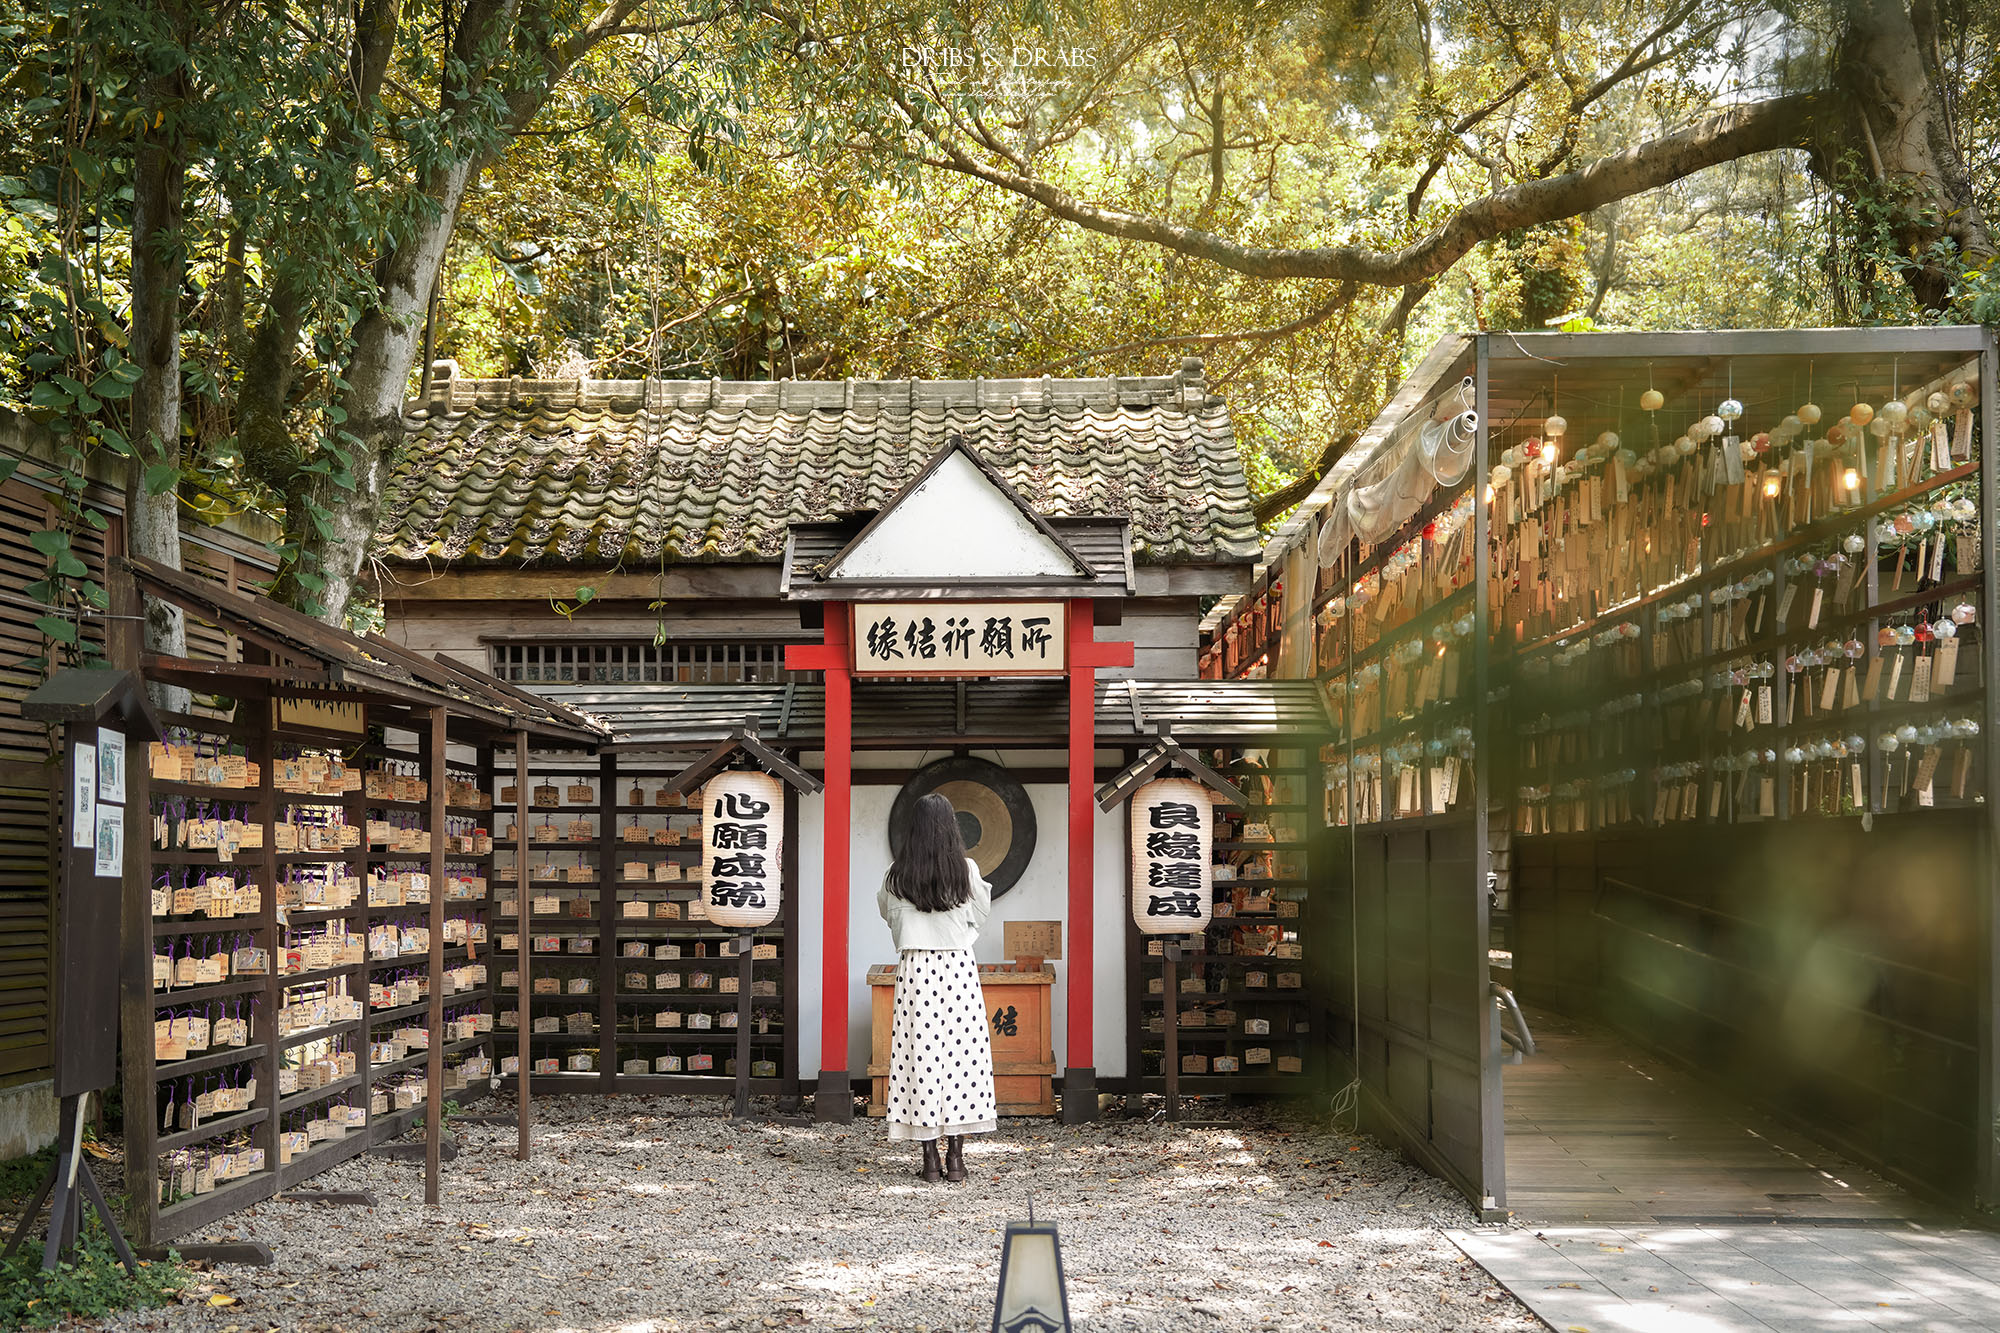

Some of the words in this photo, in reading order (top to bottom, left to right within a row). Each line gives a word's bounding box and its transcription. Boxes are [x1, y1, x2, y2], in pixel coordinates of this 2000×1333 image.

[710, 792, 771, 909] 心願成就
[1146, 801, 1202, 919] 良緣達成
[991, 1005, 1018, 1037] 結
